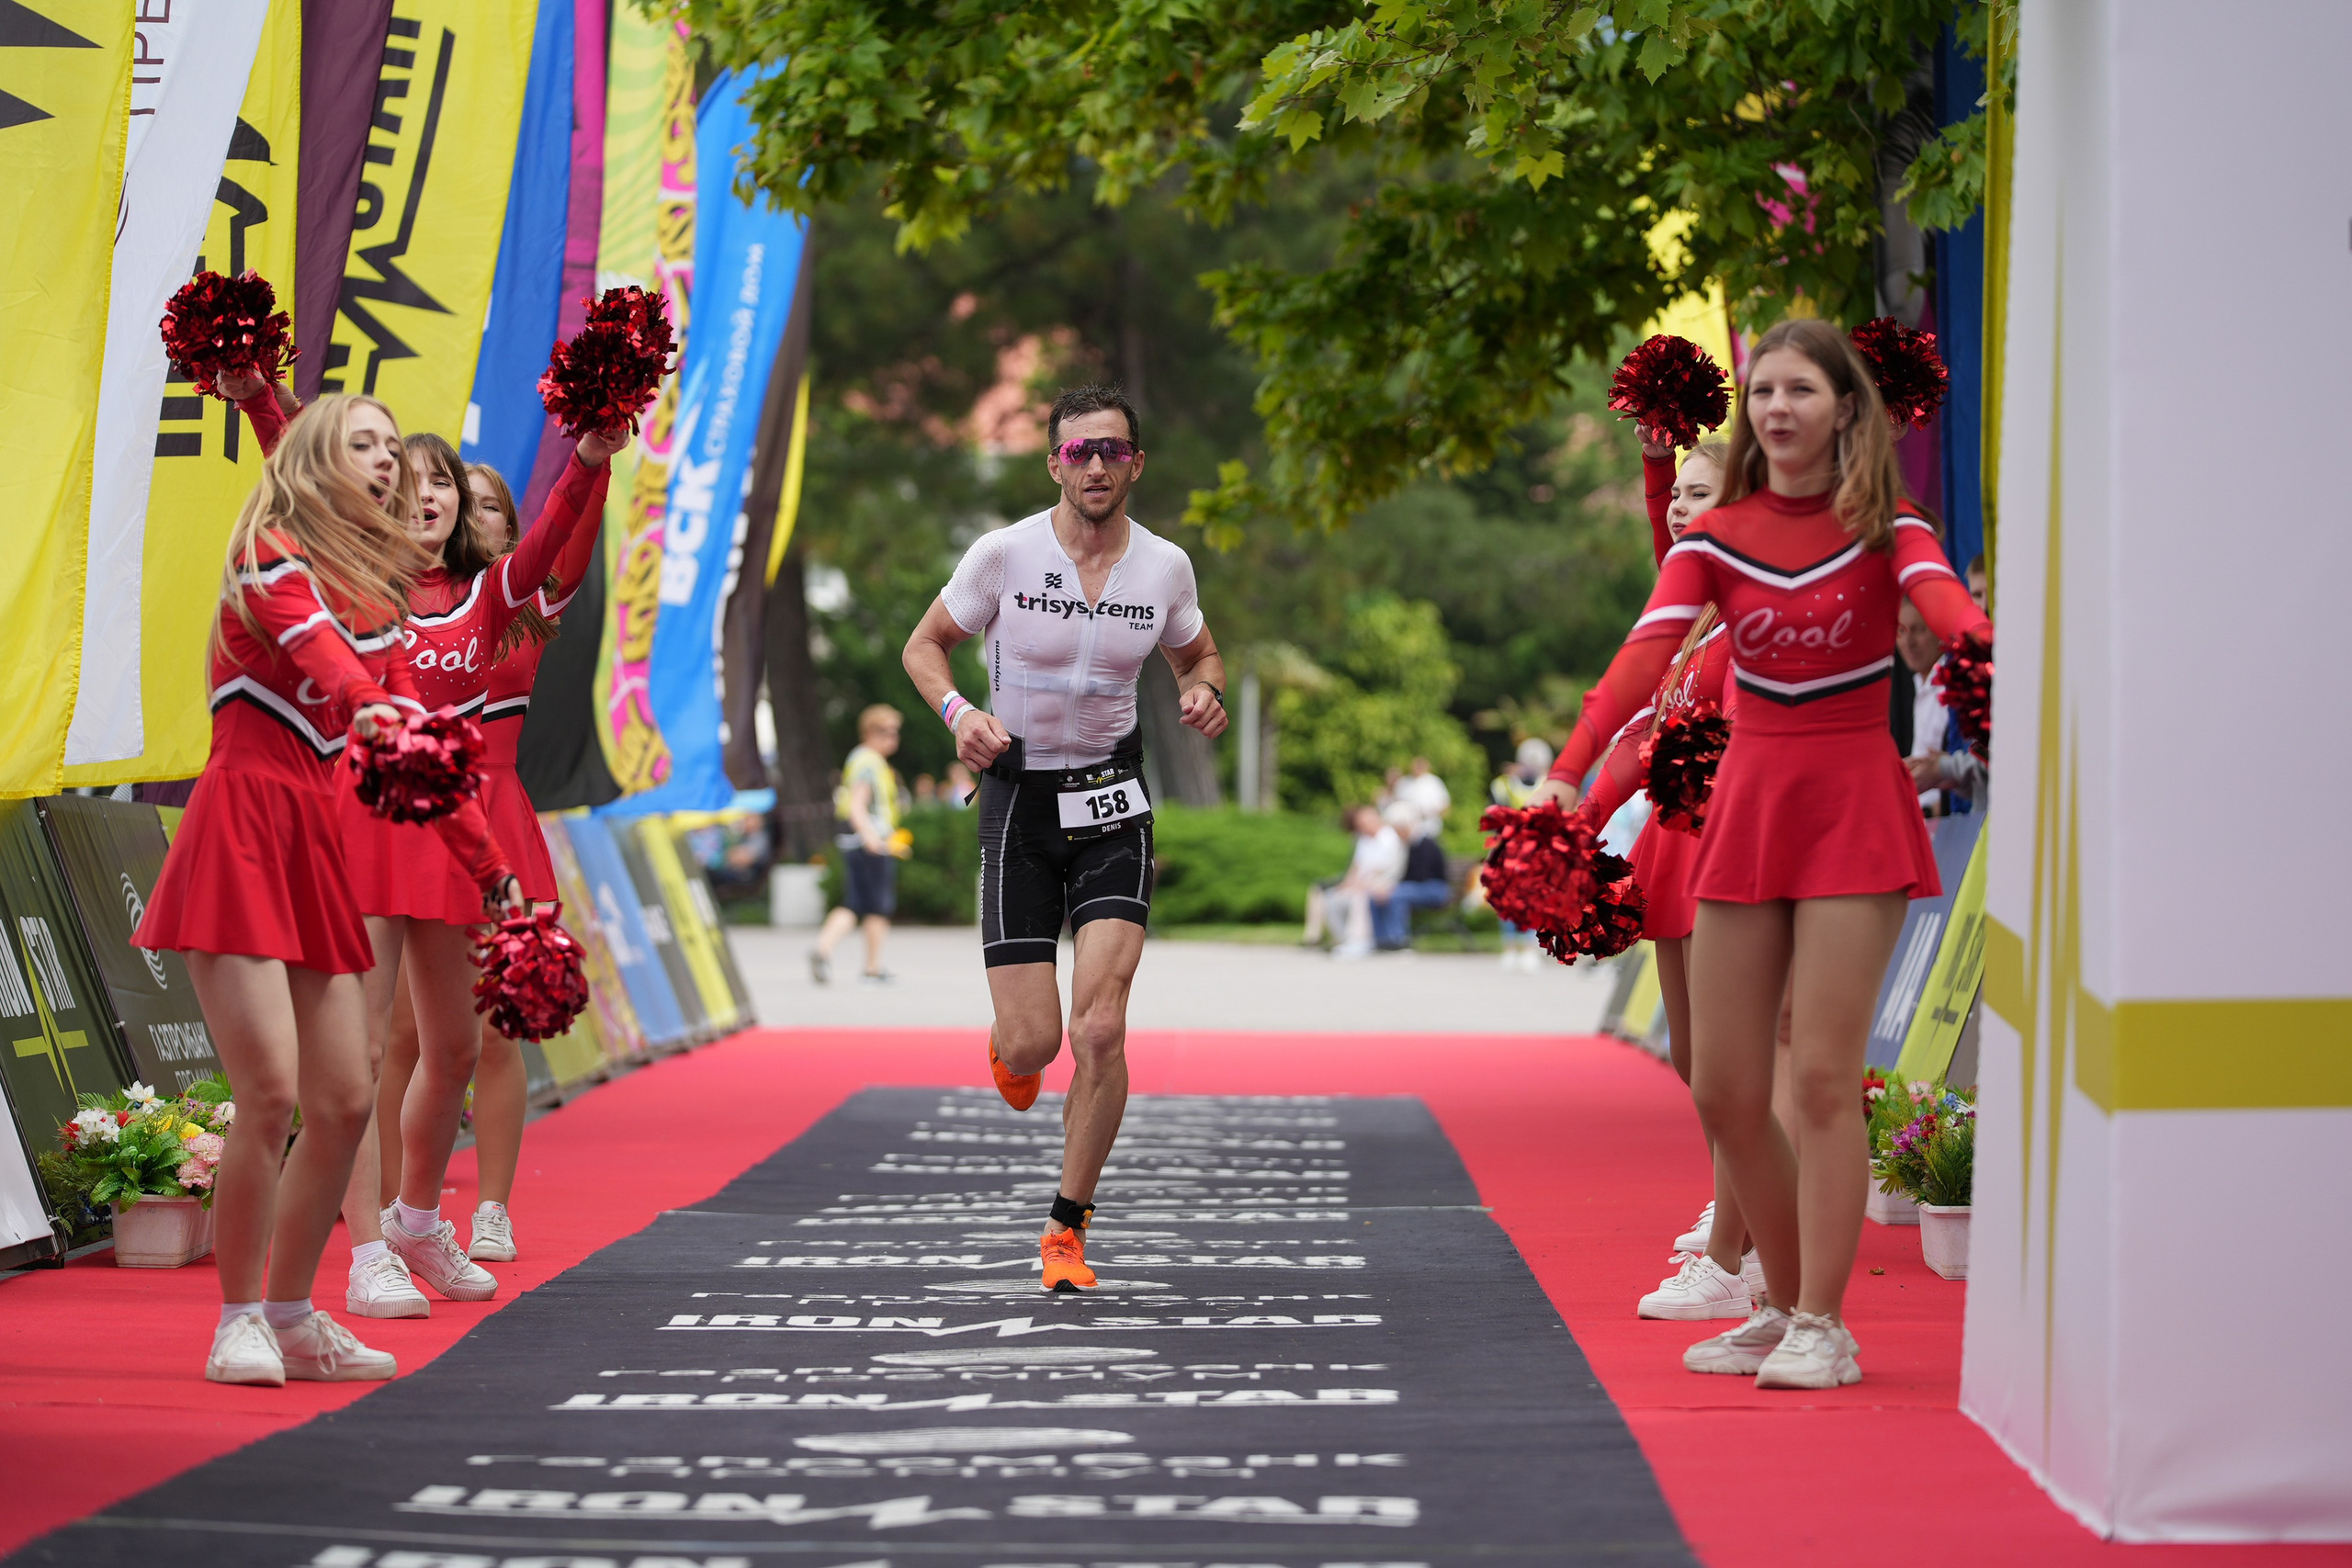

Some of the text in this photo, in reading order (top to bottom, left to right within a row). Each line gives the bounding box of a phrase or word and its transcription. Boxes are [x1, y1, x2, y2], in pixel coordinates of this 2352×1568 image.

[705, 307, 754, 457] СТРАХОВОЙ
[660, 455, 721, 605] ВСК
[1014, 591, 1155, 620] trisystems
[1129, 622, 1154, 631] TEAM
[1734, 607, 1853, 657] Cool
[1085, 789, 1130, 820] 158
[1102, 822, 1122, 833] DENIS
[147, 1021, 215, 1062] ГАЗПРОМБАНК
[741, 1255, 1366, 1266] IRON STAR
[668, 1314, 1383, 1327] IRON STAR
[563, 1388, 1398, 1405] IRON STAR
[409, 1484, 1419, 1517] IRON STAR
